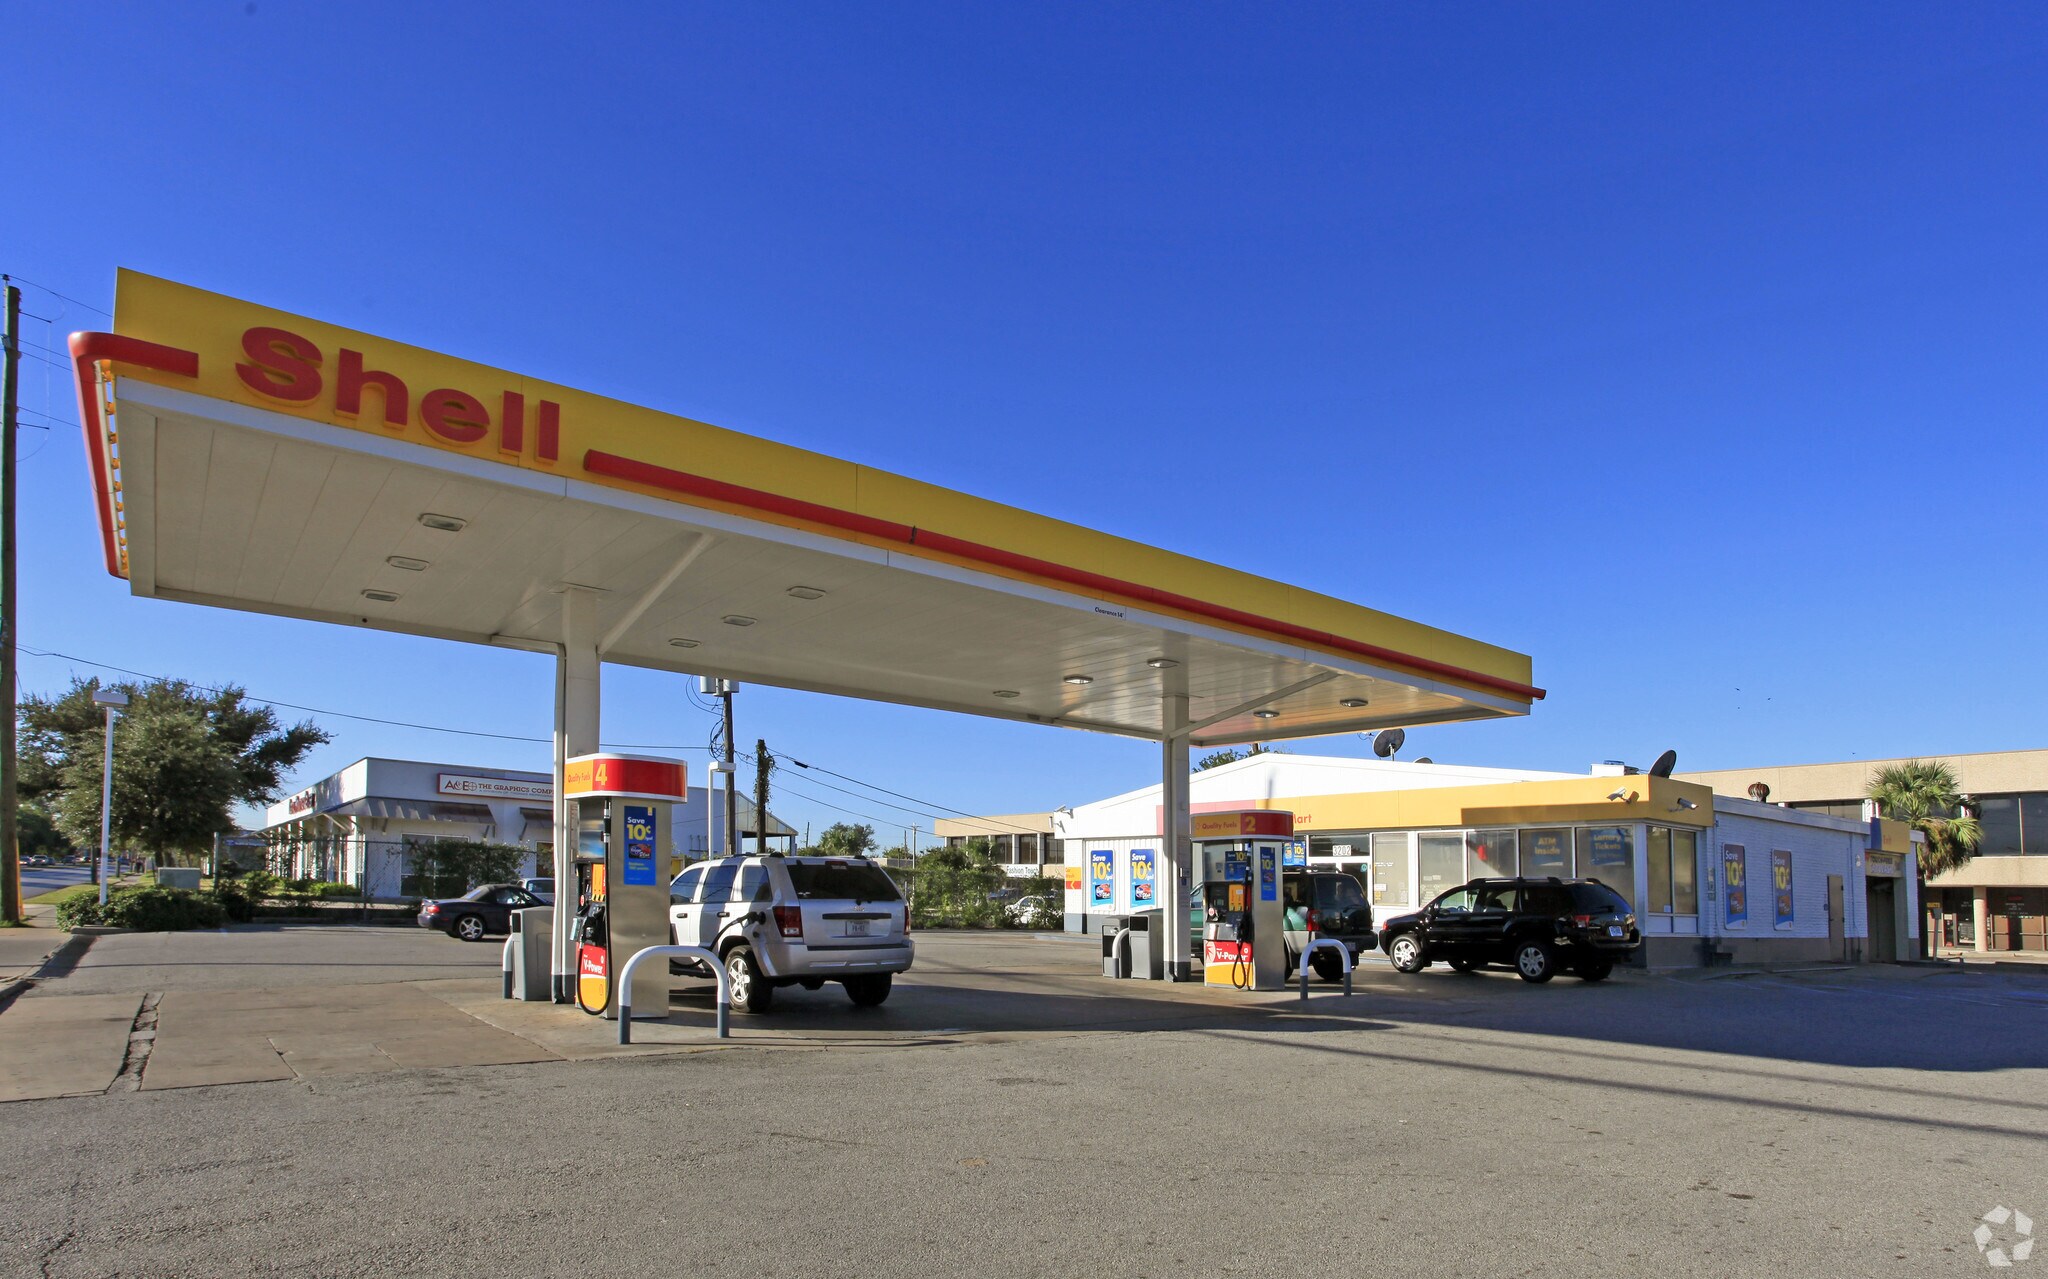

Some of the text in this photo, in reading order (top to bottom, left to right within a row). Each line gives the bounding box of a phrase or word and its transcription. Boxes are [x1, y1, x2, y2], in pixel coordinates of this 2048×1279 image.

[235, 327, 560, 463] Shell
[595, 763, 608, 786] 4
[494, 784, 530, 793] GRAPHICS
[627, 816, 645, 824] Save
[1245, 816, 1256, 832] 2
[1202, 821, 1223, 830] Quality
[1538, 837, 1556, 846] ATM
[1594, 834, 1621, 842] Lottery
[1534, 846, 1560, 855] Inside
[1594, 842, 1621, 850] Tickets
[1333, 845, 1351, 857] 3202
[1725, 850, 1738, 860] Save
[1131, 853, 1146, 861] Save
[1774, 856, 1785, 865] Save
[1007, 865, 1024, 874] Fashion
